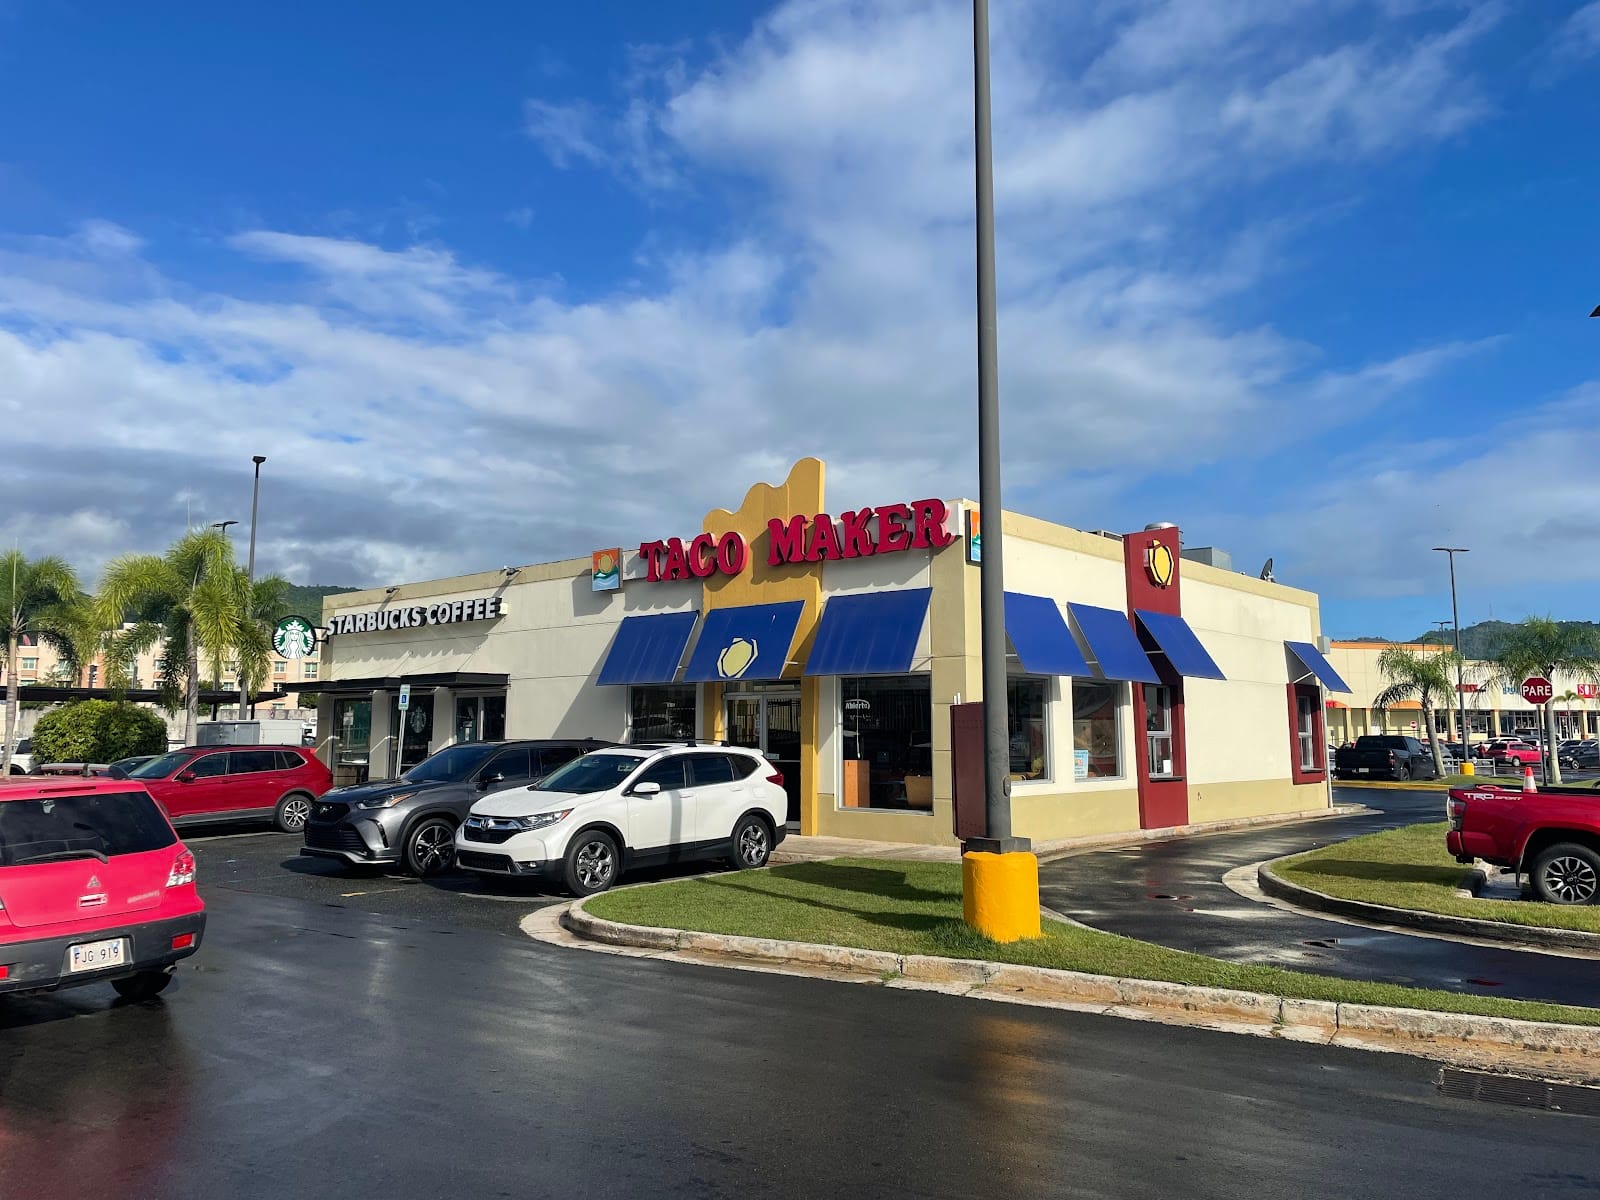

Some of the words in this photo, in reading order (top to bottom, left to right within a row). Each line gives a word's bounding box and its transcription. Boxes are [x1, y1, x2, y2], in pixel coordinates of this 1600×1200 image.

[639, 531, 749, 582] TACO
[767, 498, 956, 566] MAKER
[326, 606, 425, 636] STARBUCKS
[426, 598, 500, 625] COFFEE
[1522, 685, 1552, 697] PARE
[1463, 792, 1495, 801] TRD
[74, 950, 94, 965] FJG
[100, 946, 119, 960] 919
